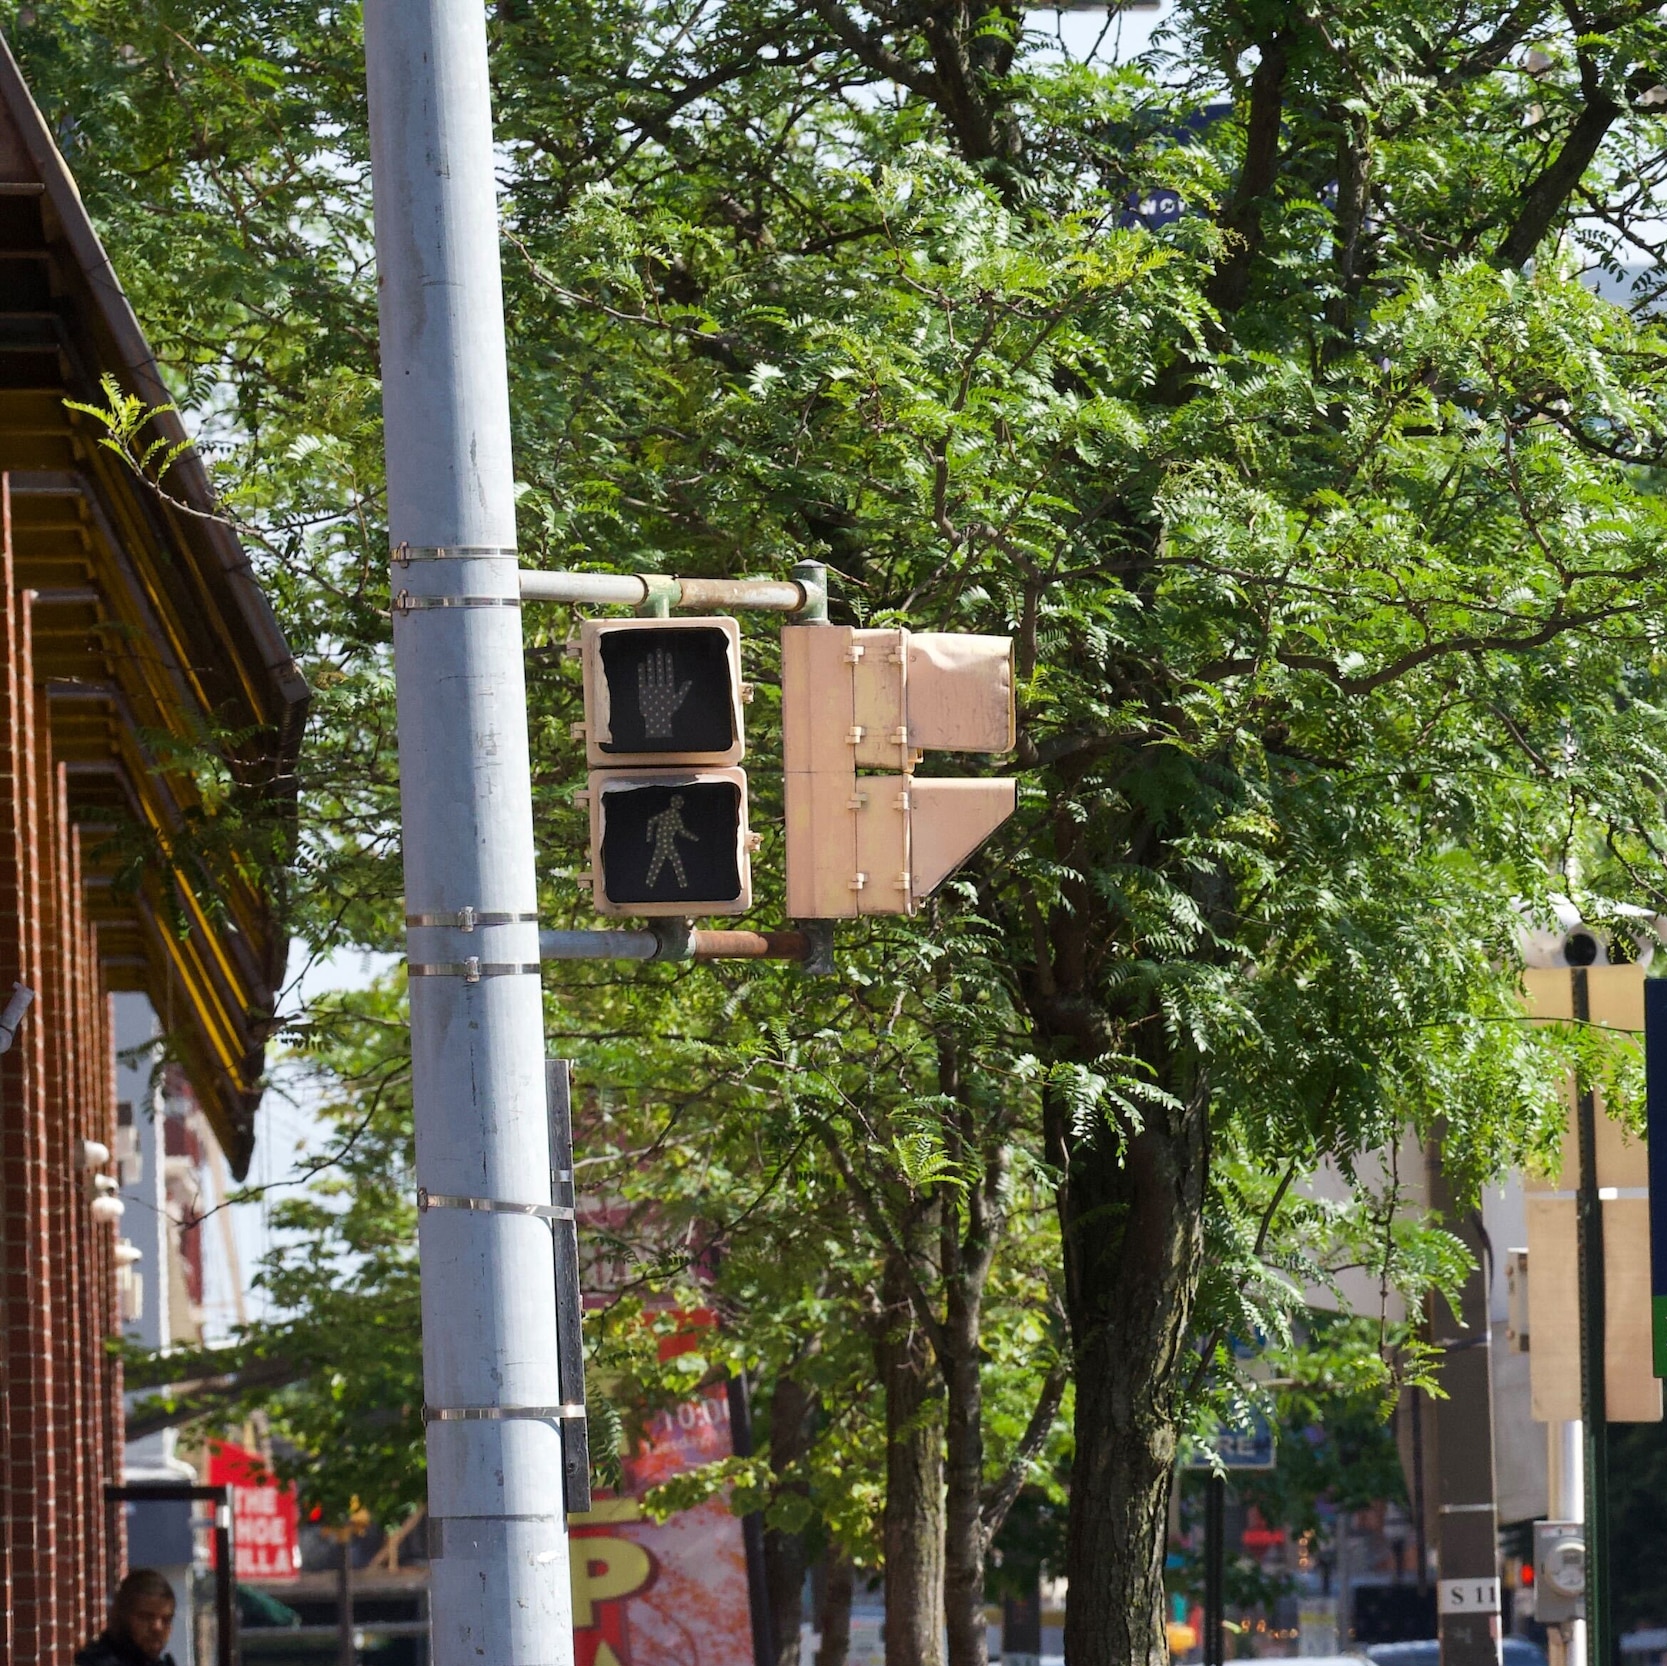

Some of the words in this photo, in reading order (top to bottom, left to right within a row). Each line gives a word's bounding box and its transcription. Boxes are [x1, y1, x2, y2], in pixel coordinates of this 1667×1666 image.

[235, 1518, 286, 1544] HOE
[235, 1547, 290, 1573] ILLA
[1451, 1586, 1464, 1605] S
